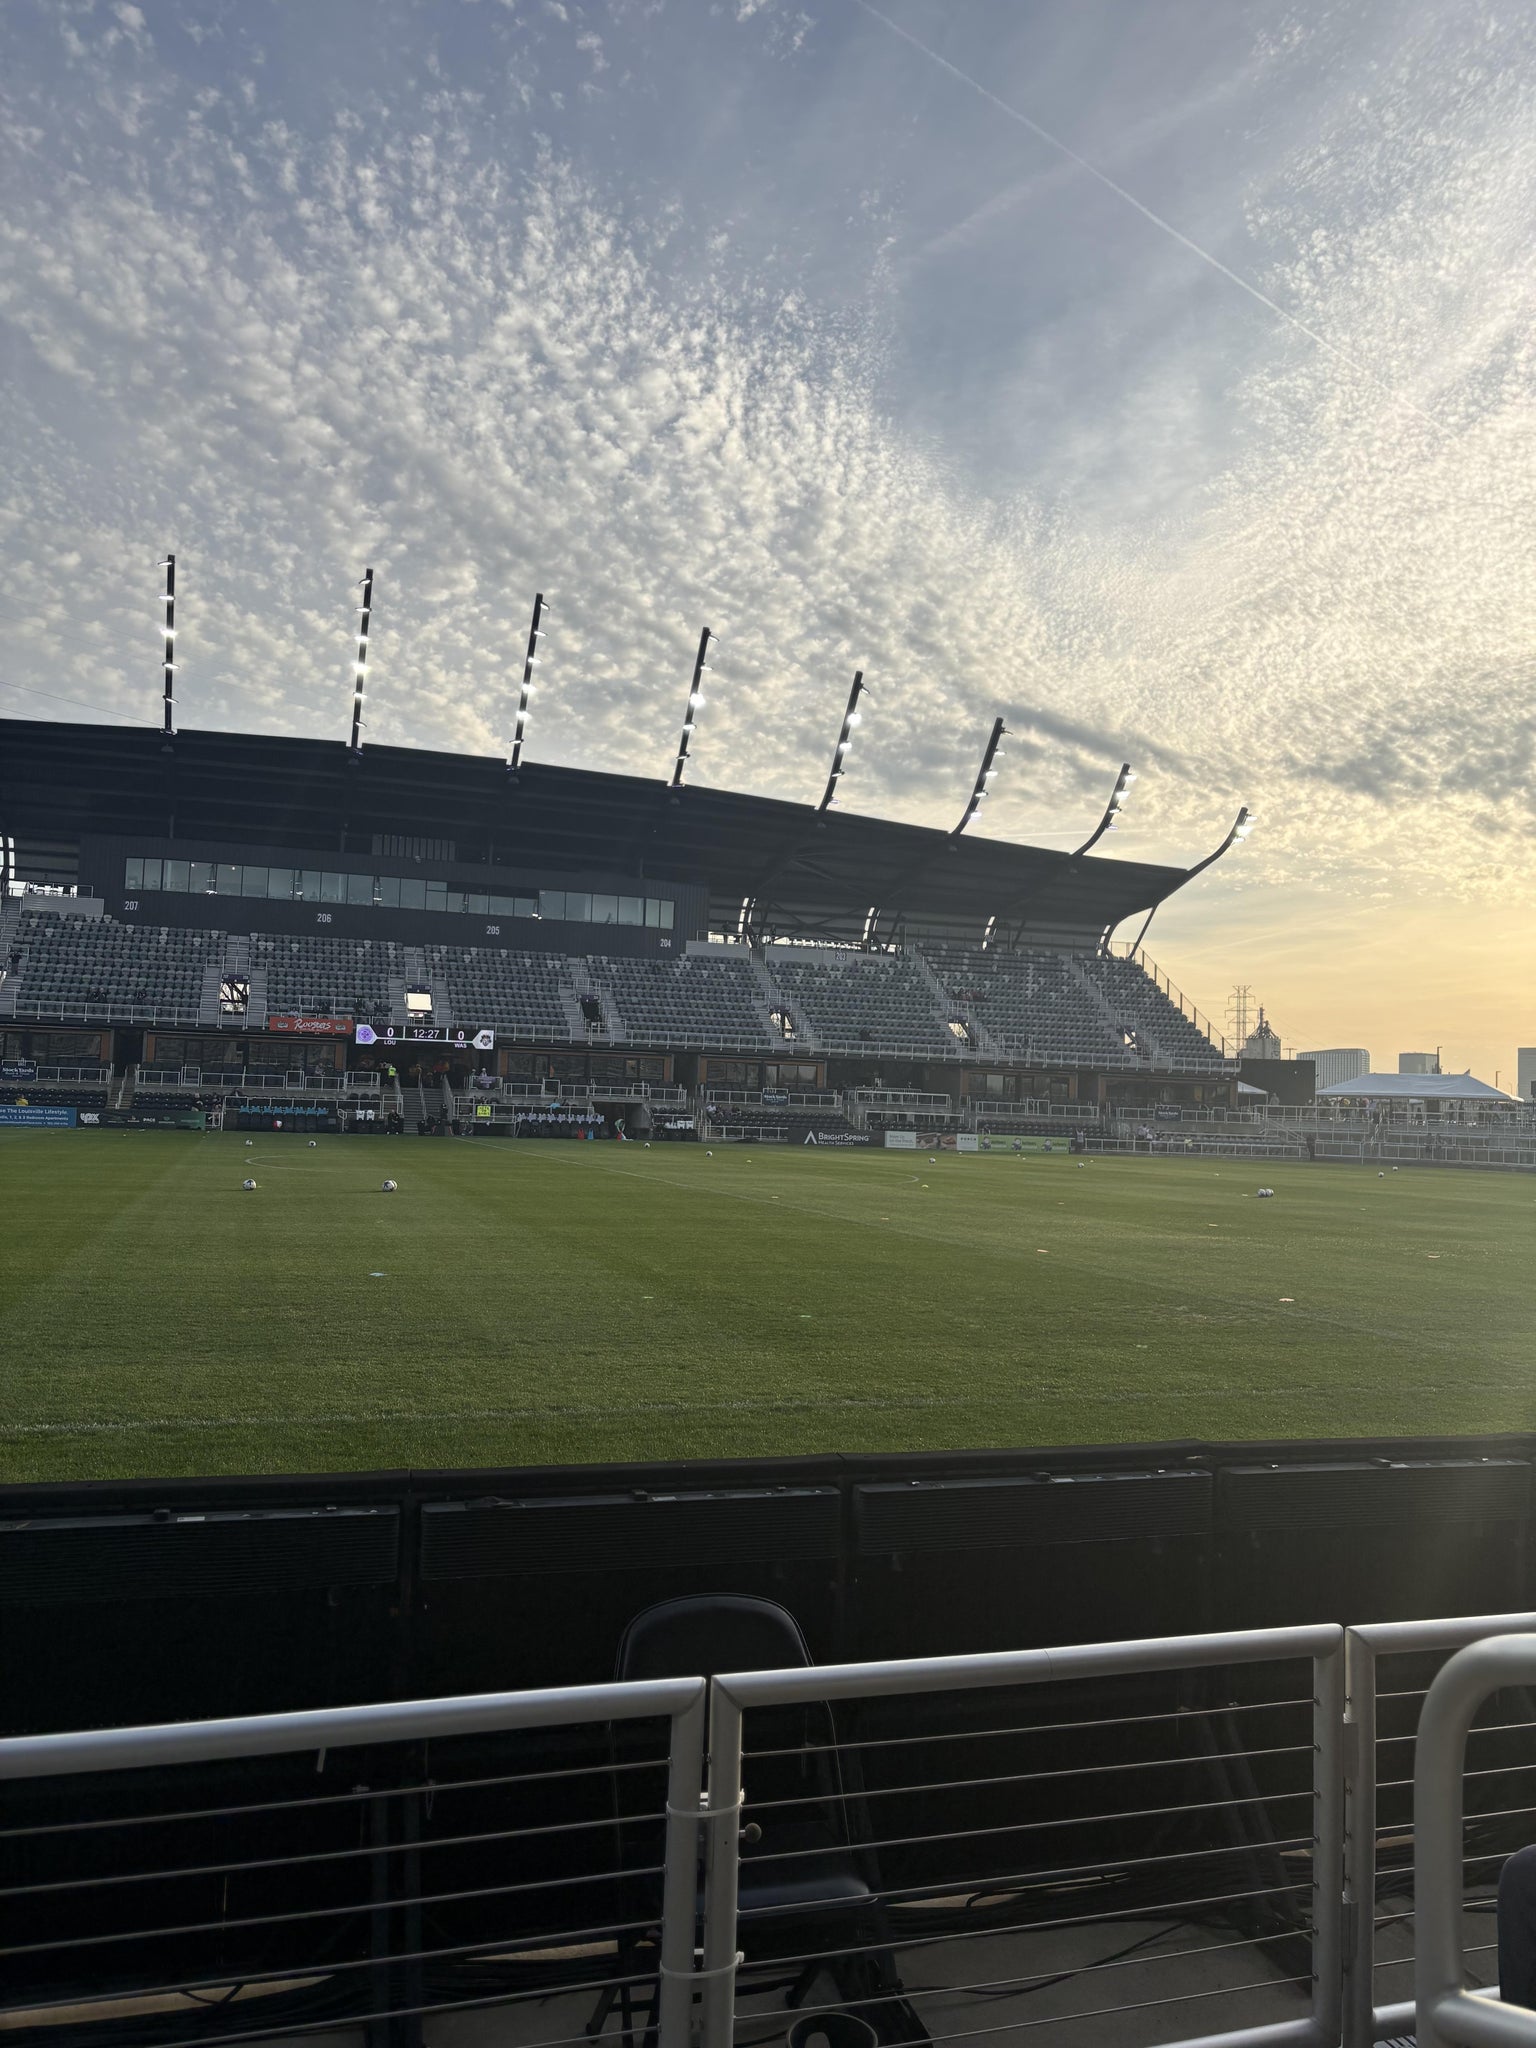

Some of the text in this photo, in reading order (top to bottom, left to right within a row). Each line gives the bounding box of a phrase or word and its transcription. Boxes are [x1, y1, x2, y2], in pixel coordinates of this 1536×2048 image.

[124, 901, 138, 911] 207
[317, 913, 331, 923] 206
[486, 925, 500, 935] 205
[659, 938, 671, 948] 204
[294, 1018, 332, 1030] Roosters
[387, 1027, 394, 1037] 0
[413, 1028, 440, 1039] 12:27
[457, 1030, 465, 1041] 0
